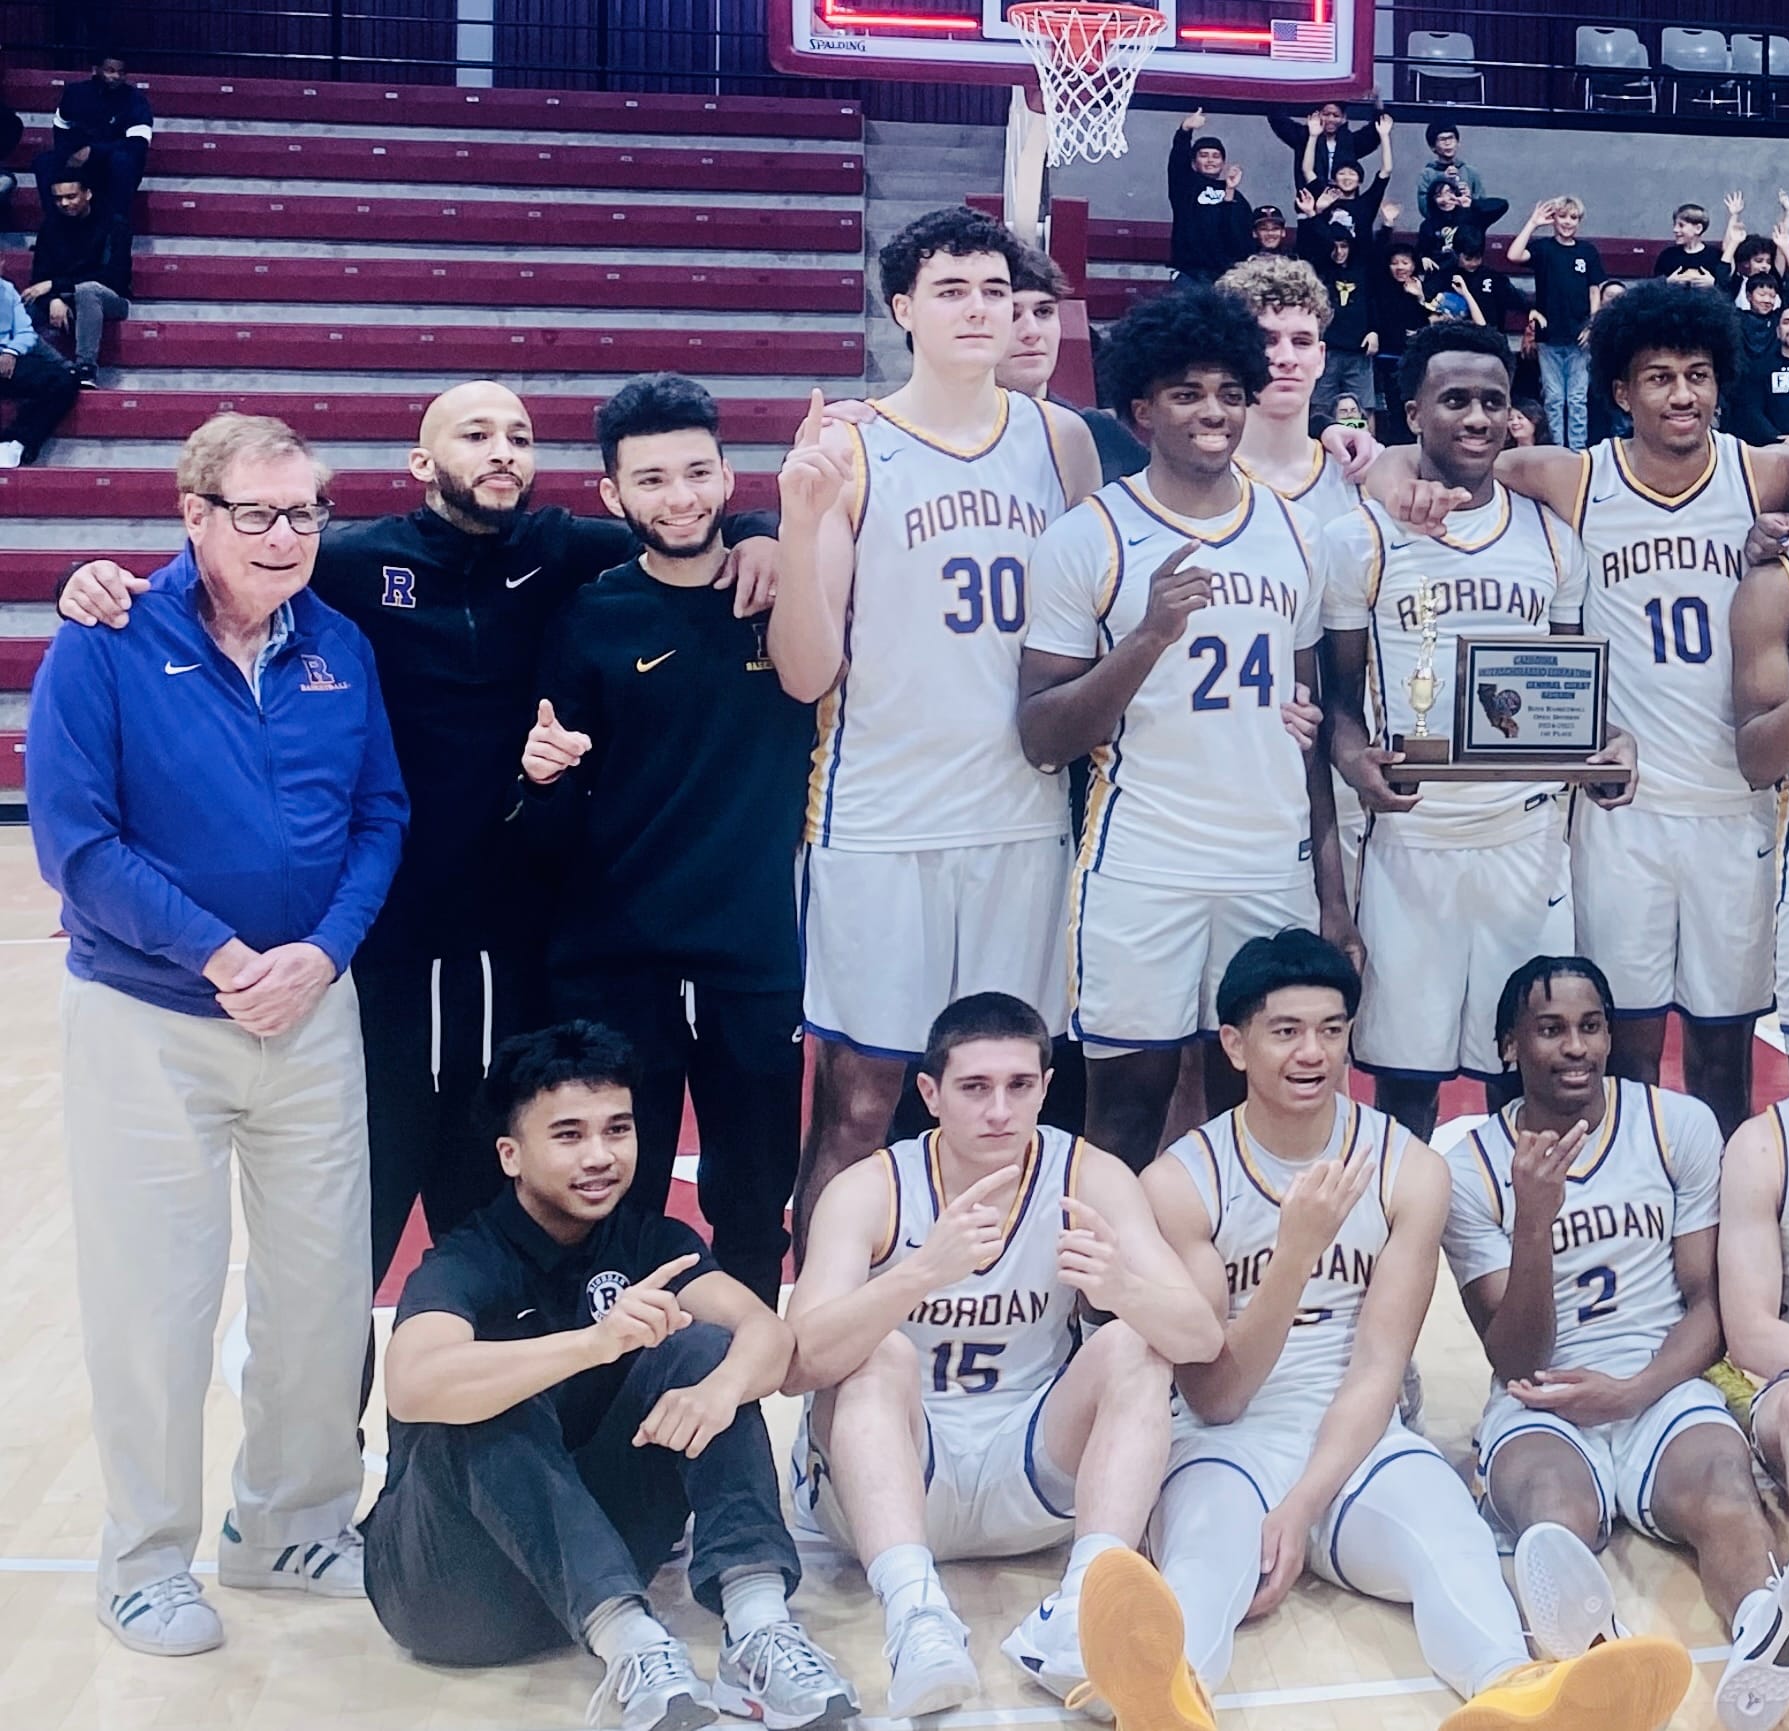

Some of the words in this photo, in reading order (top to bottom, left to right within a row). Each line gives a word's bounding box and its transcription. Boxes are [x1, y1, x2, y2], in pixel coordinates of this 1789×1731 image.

[809, 38, 866, 52] SPALDING
[905, 488, 1047, 551] RIORDAN
[381, 565, 417, 609] R
[1602, 536, 1742, 589] RIORDAN
[942, 556, 1026, 634] 30
[1209, 571, 1297, 625] RDAN
[1397, 577, 1546, 632] RORDAN
[1644, 596, 1713, 664] 10
[300, 653, 336, 685] R
[1189, 633, 1274, 712] 24
[1550, 1201, 1665, 1255] ORDAN
[1225, 1243, 1373, 1295] RIOAN
[1577, 1265, 1618, 1324] 2
[932, 1342, 1008, 1394] 15
